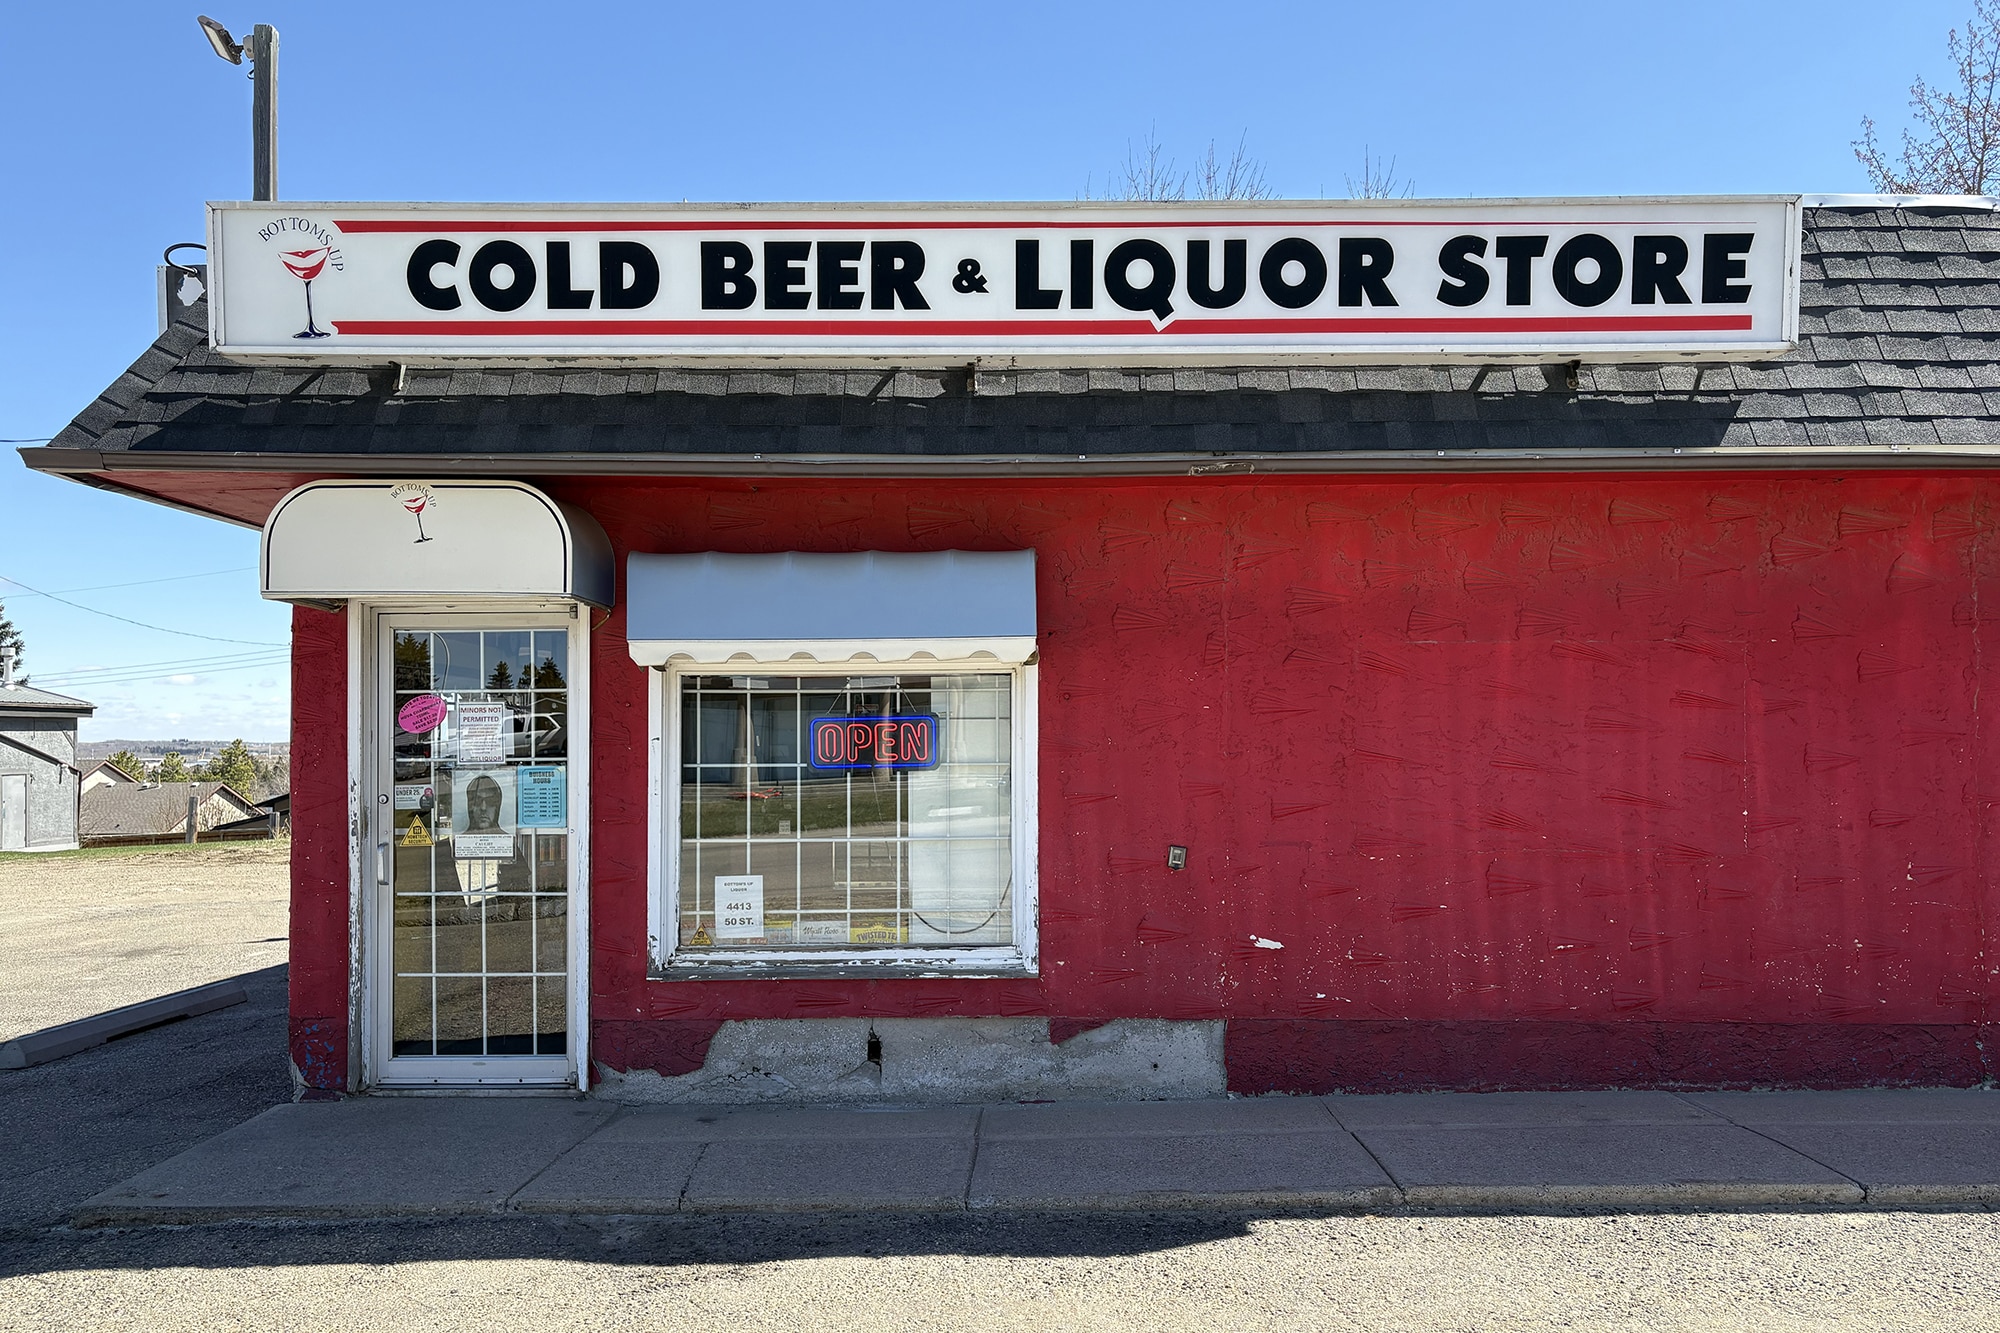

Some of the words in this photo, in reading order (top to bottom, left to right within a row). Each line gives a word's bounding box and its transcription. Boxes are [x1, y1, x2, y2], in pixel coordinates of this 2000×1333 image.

[258, 217, 333, 246] BOTTOMS
[329, 249, 344, 272] UP
[407, 239, 660, 312] COLD
[701, 240, 931, 310] BEER
[952, 258, 989, 294] &
[1016, 238, 1400, 322] LIQUOR
[1436, 233, 1755, 307] STORE
[391, 483, 430, 499] BOTTOMS
[428, 496, 437, 507] UP
[818, 722, 928, 762] OPEN
[726, 902, 752, 910] 4413
[724, 917, 737, 926] 50
[739, 917, 754, 925] ST.
[856, 931, 887, 941] TWISTED
